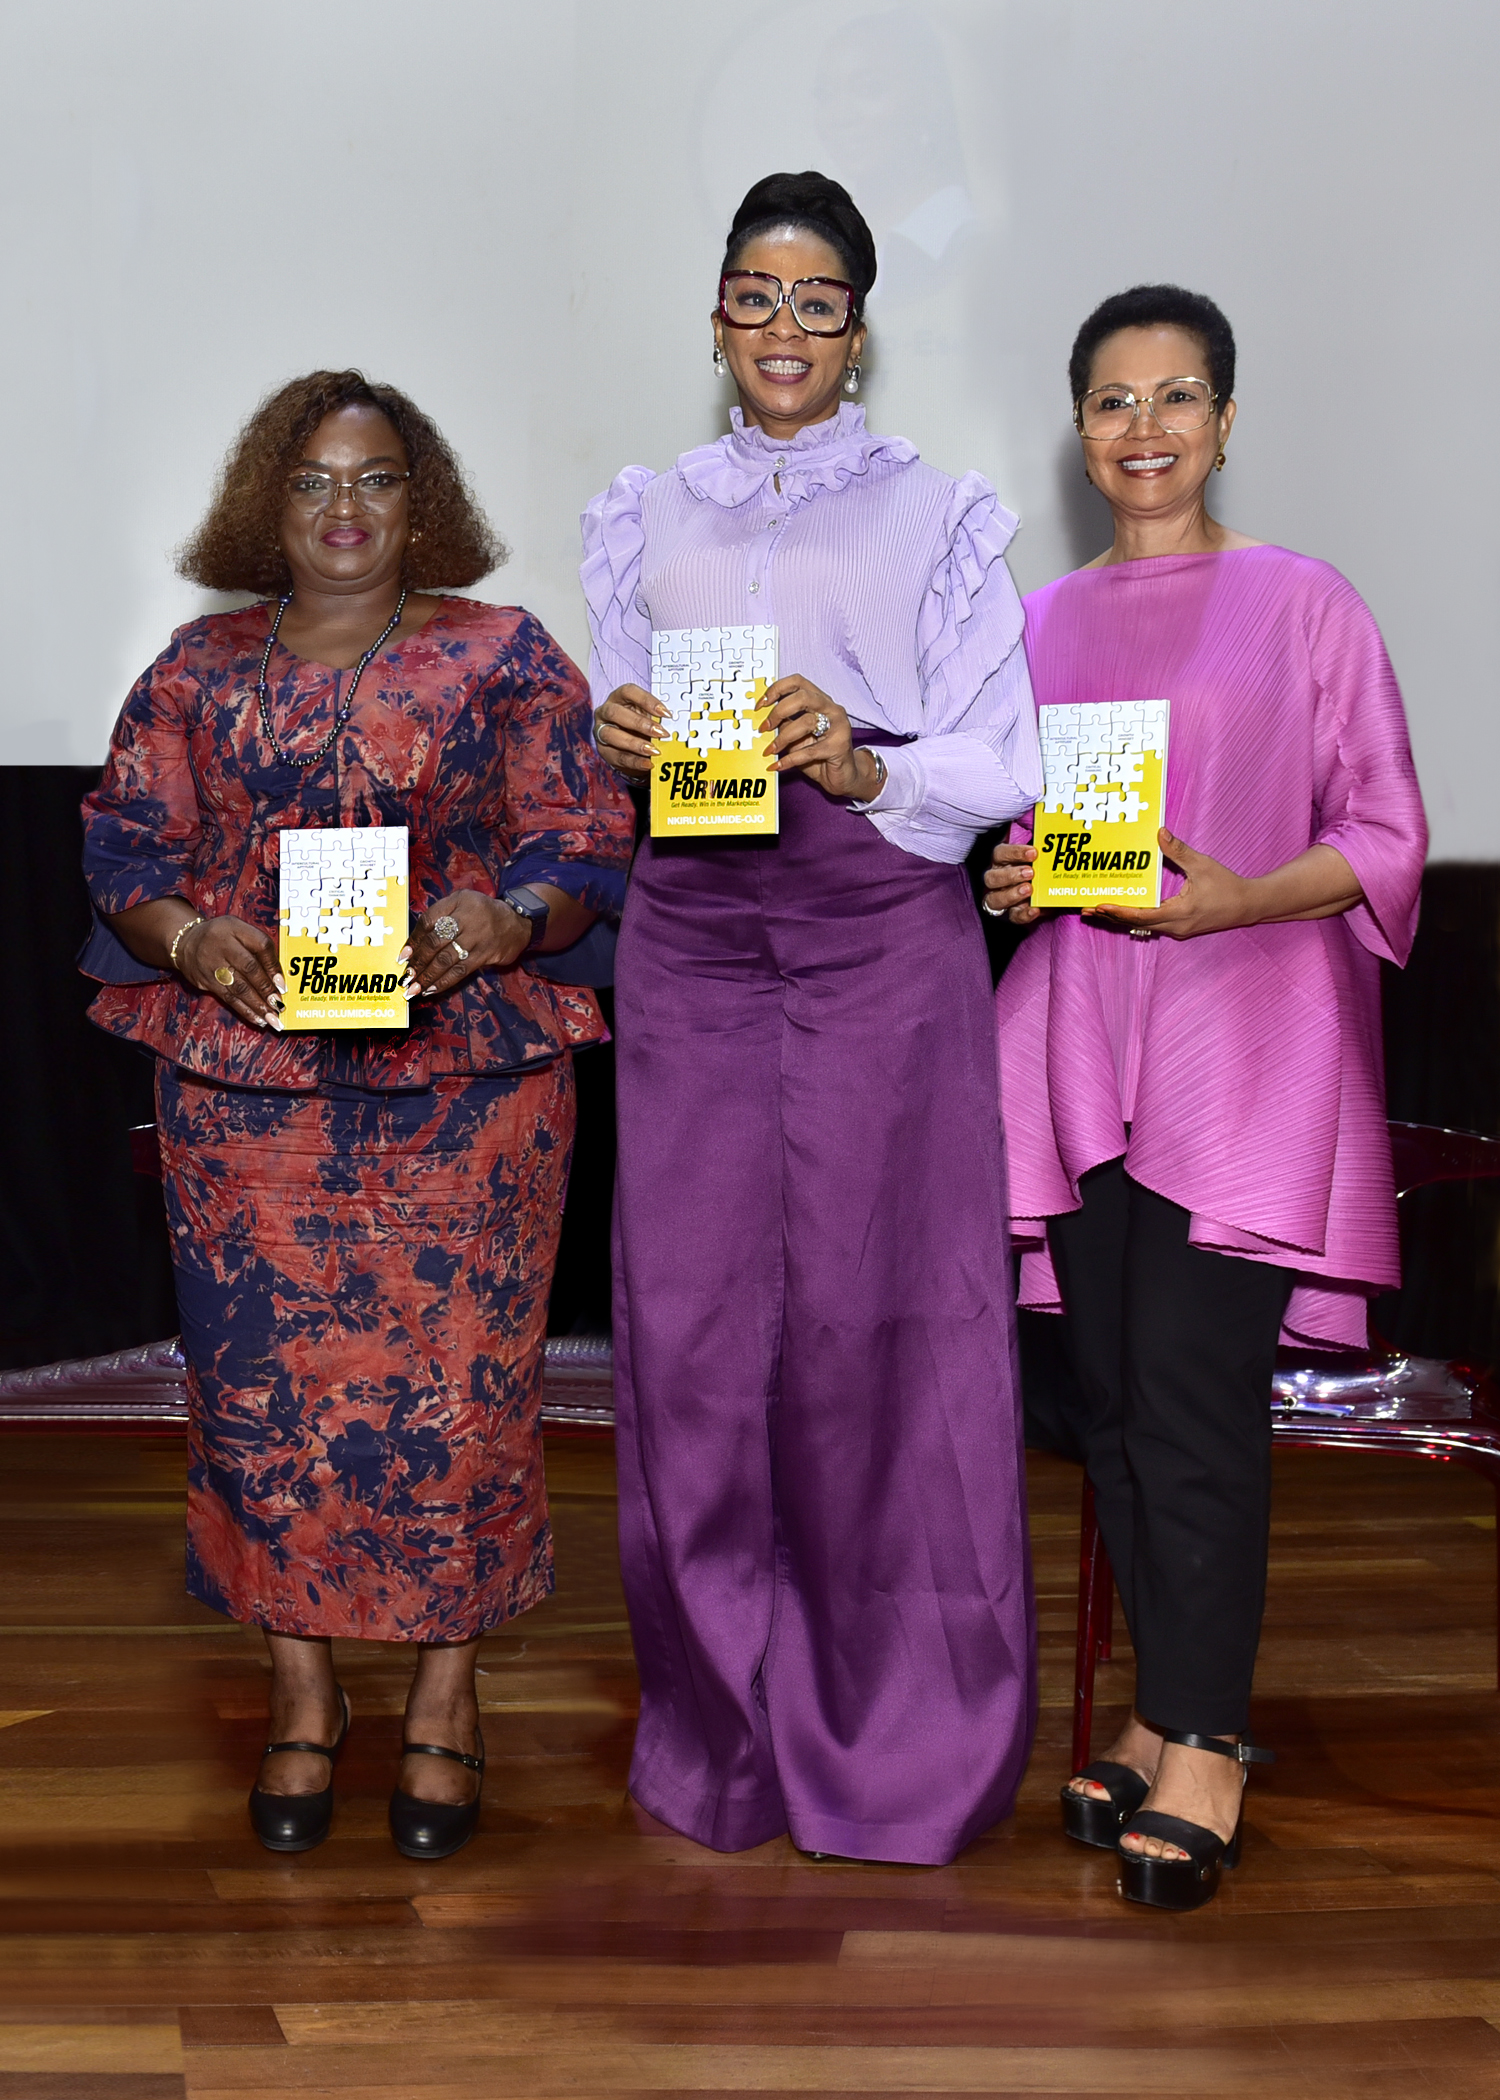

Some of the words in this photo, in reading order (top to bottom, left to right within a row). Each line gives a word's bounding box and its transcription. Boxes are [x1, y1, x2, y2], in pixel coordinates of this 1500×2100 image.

[659, 761, 707, 781] STEP
[670, 779, 766, 800] FORWARD
[667, 817, 696, 825] NKIRU
[698, 815, 765, 824] OLUMIDE-OJO
[1042, 833, 1091, 852] STEP
[1052, 851, 1151, 871] FORWARD
[1049, 888, 1077, 896] NKIRU
[1080, 887, 1147, 896] OLUMIDE-OJO
[288, 956, 337, 976] STEP
[299, 974, 397, 994] FORWARD
[296, 1010, 325, 1018] NKIRU
[328, 1009, 395, 1018] OLUMIDE-OJO
